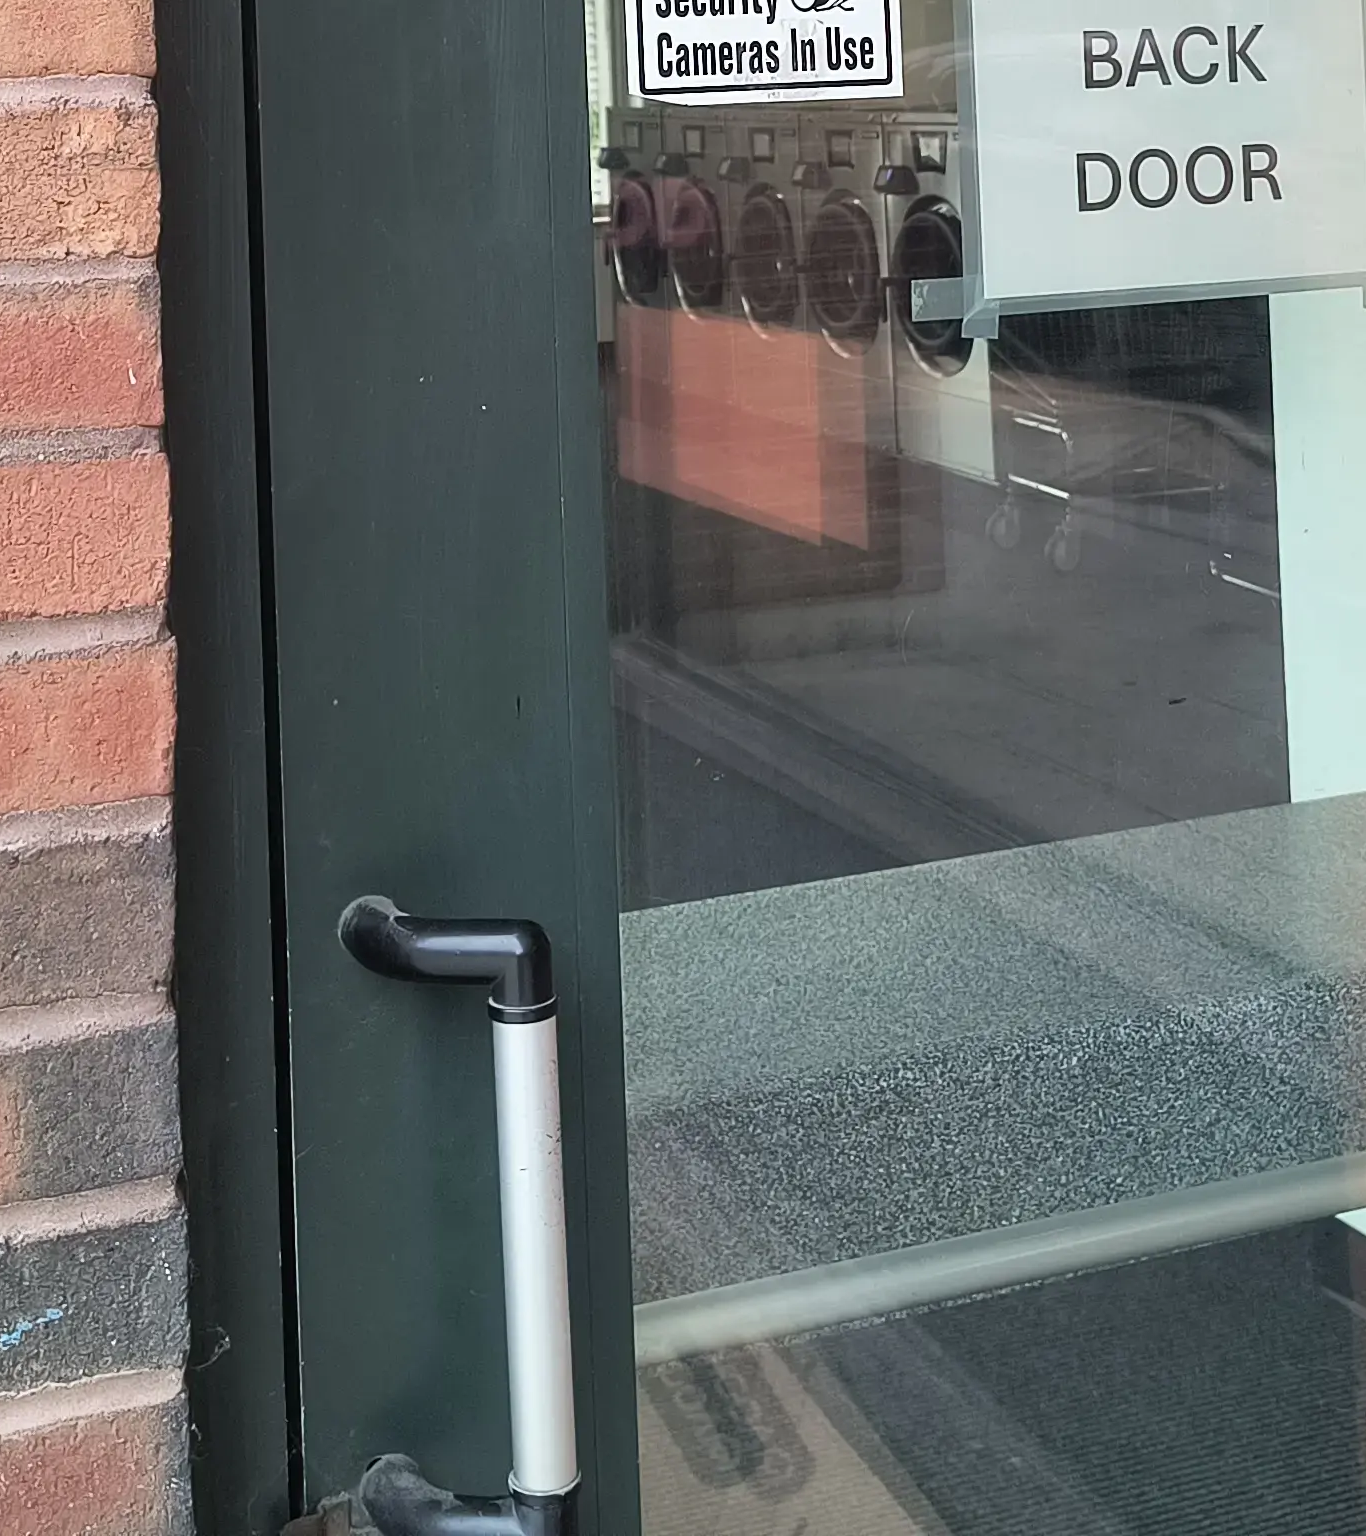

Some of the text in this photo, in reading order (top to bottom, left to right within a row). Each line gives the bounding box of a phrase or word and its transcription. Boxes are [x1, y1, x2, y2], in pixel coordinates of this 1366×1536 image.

[656, 26, 874, 78] Cameras In Use
[1082, 23, 1268, 89] BACK
[1075, 143, 1283, 212] DOOR
